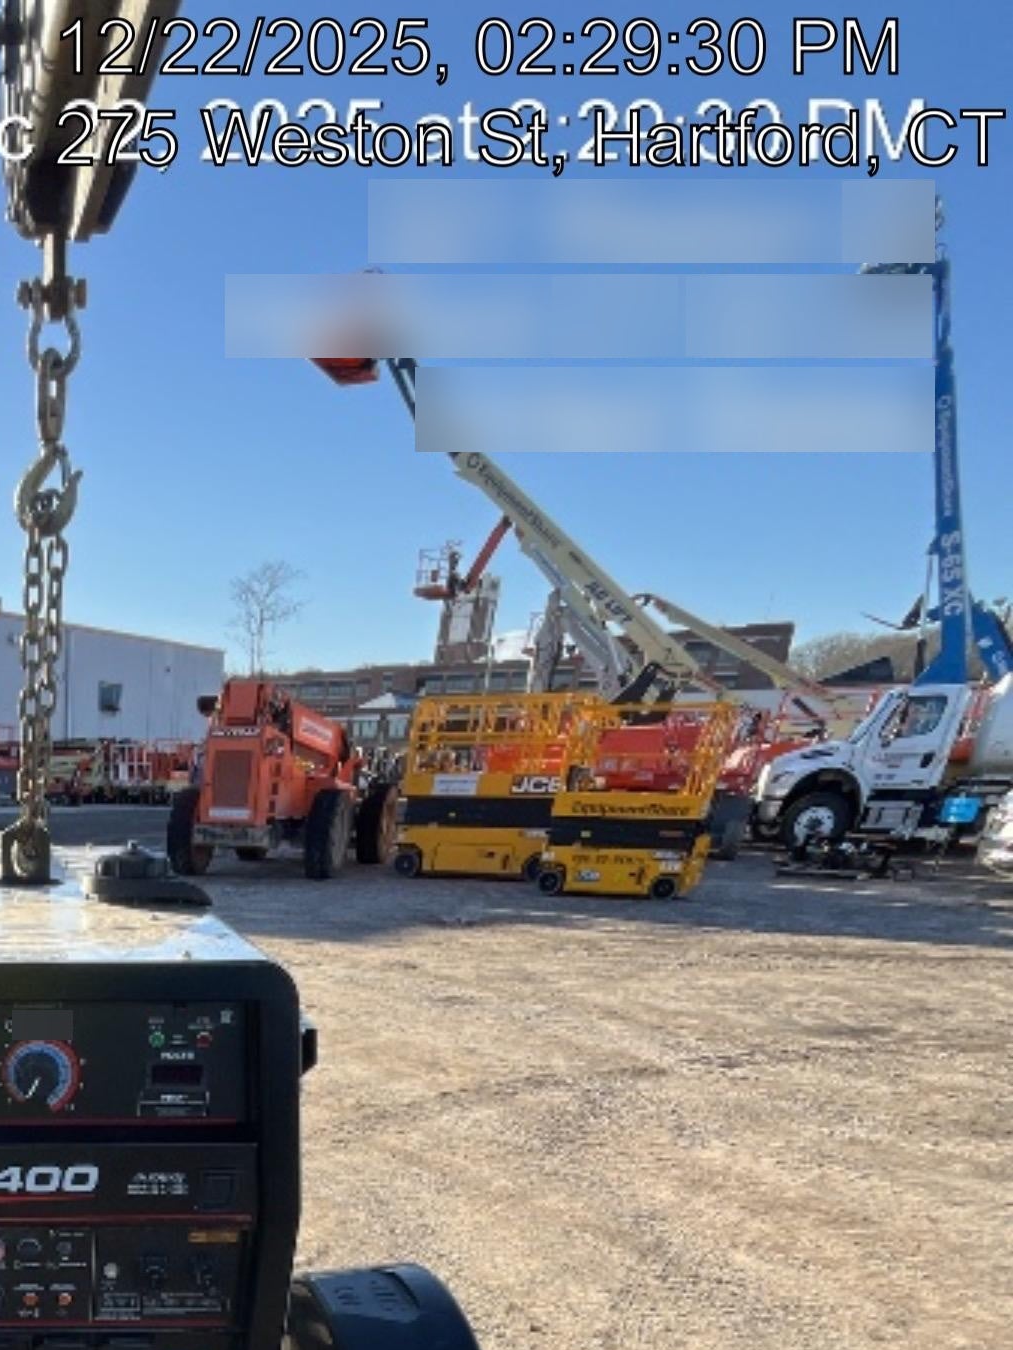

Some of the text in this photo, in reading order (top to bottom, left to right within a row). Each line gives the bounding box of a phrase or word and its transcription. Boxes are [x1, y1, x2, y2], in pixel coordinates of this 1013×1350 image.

[941, 530, 965, 617] S-65 XC
[571, 800, 691, 817] EquipmentShare
